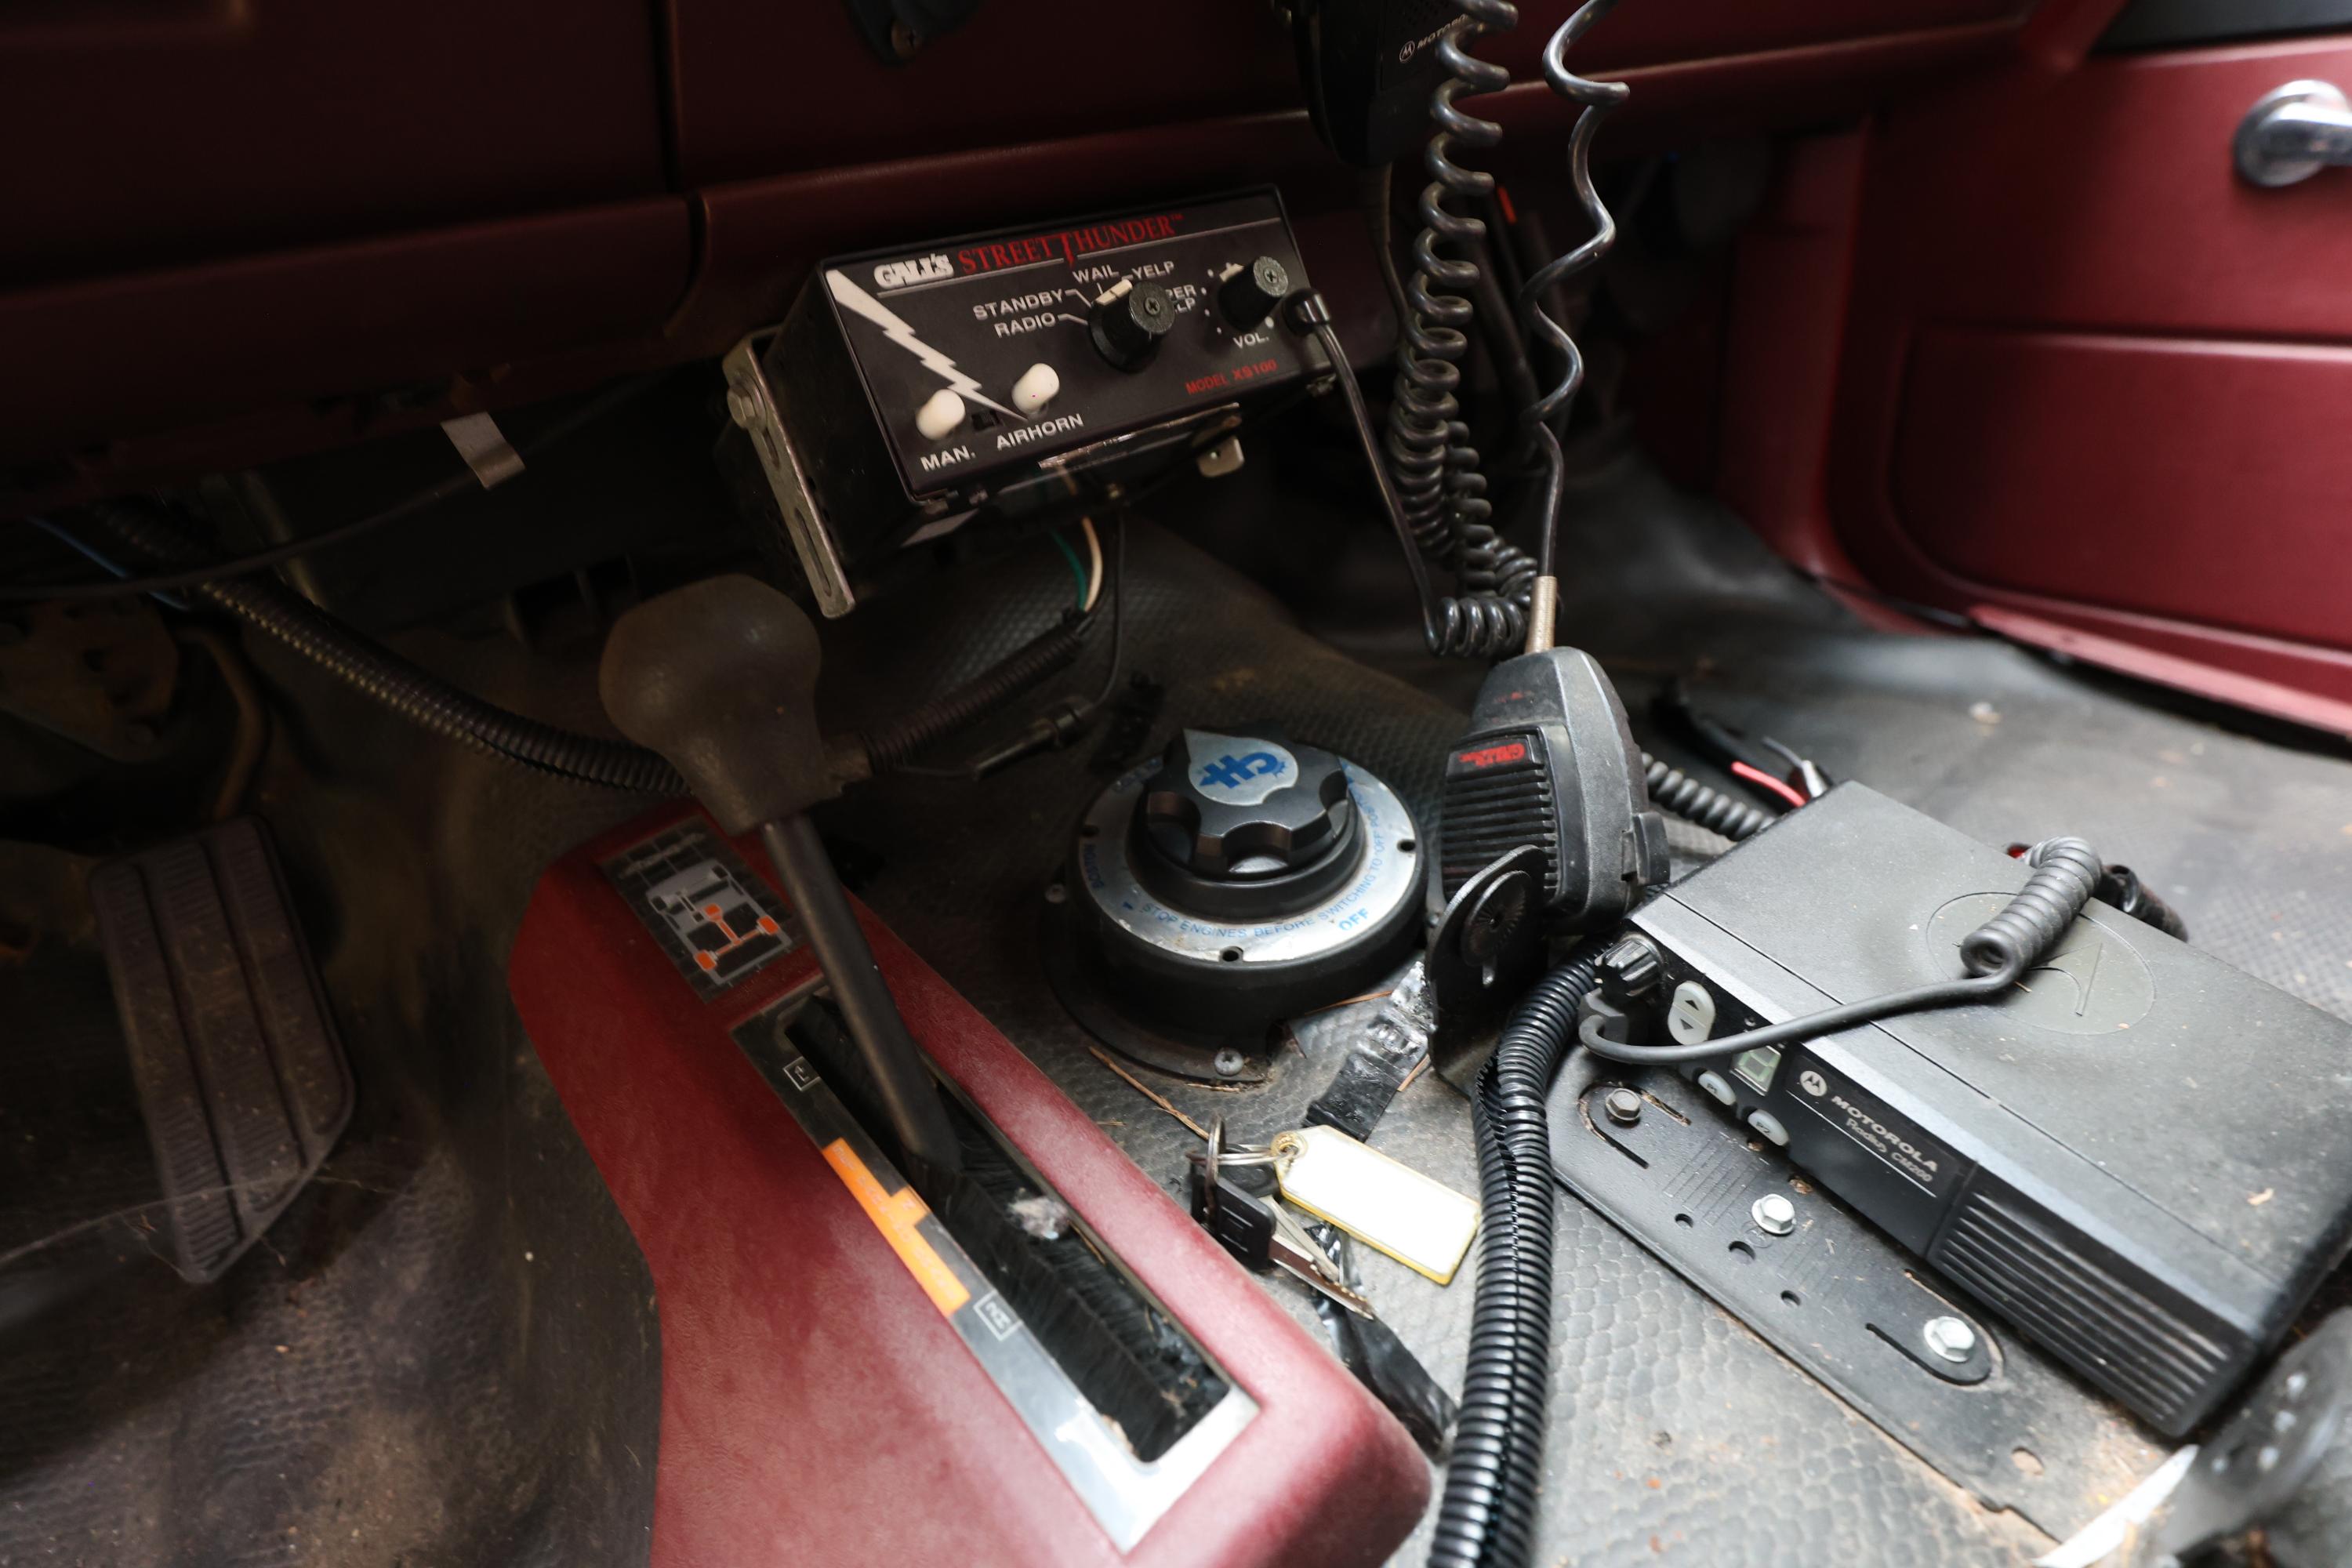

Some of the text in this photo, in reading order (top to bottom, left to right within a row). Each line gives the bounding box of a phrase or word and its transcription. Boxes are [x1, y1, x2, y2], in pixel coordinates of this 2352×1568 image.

[957, 235, 1054, 274] STREET
[1072, 264, 1120, 285] WAIL
[1131, 260, 1174, 281] YELP
[972, 288, 1063, 321] STANDBY
[993, 312, 1057, 339] RADIO
[1232, 332, 1270, 349] VOL.
[1185, 358, 1278, 395] MODEL XS100
[996, 412, 1084, 452] AIRHORN
[920, 445, 977, 472] MAN.
[1142, 902, 1180, 924] STOP
[1179, 920, 1248, 938] ENGINES
[1254, 916, 1315, 937] BEFORE
[1316, 873, 1377, 921] SWITCHING
[1369, 858, 1383, 873] TO
[1338, 907, 1369, 931] OFF
[1831, 1095, 1939, 1173] MOTOROLA
[1891, 1152, 1933, 1182] CM200
